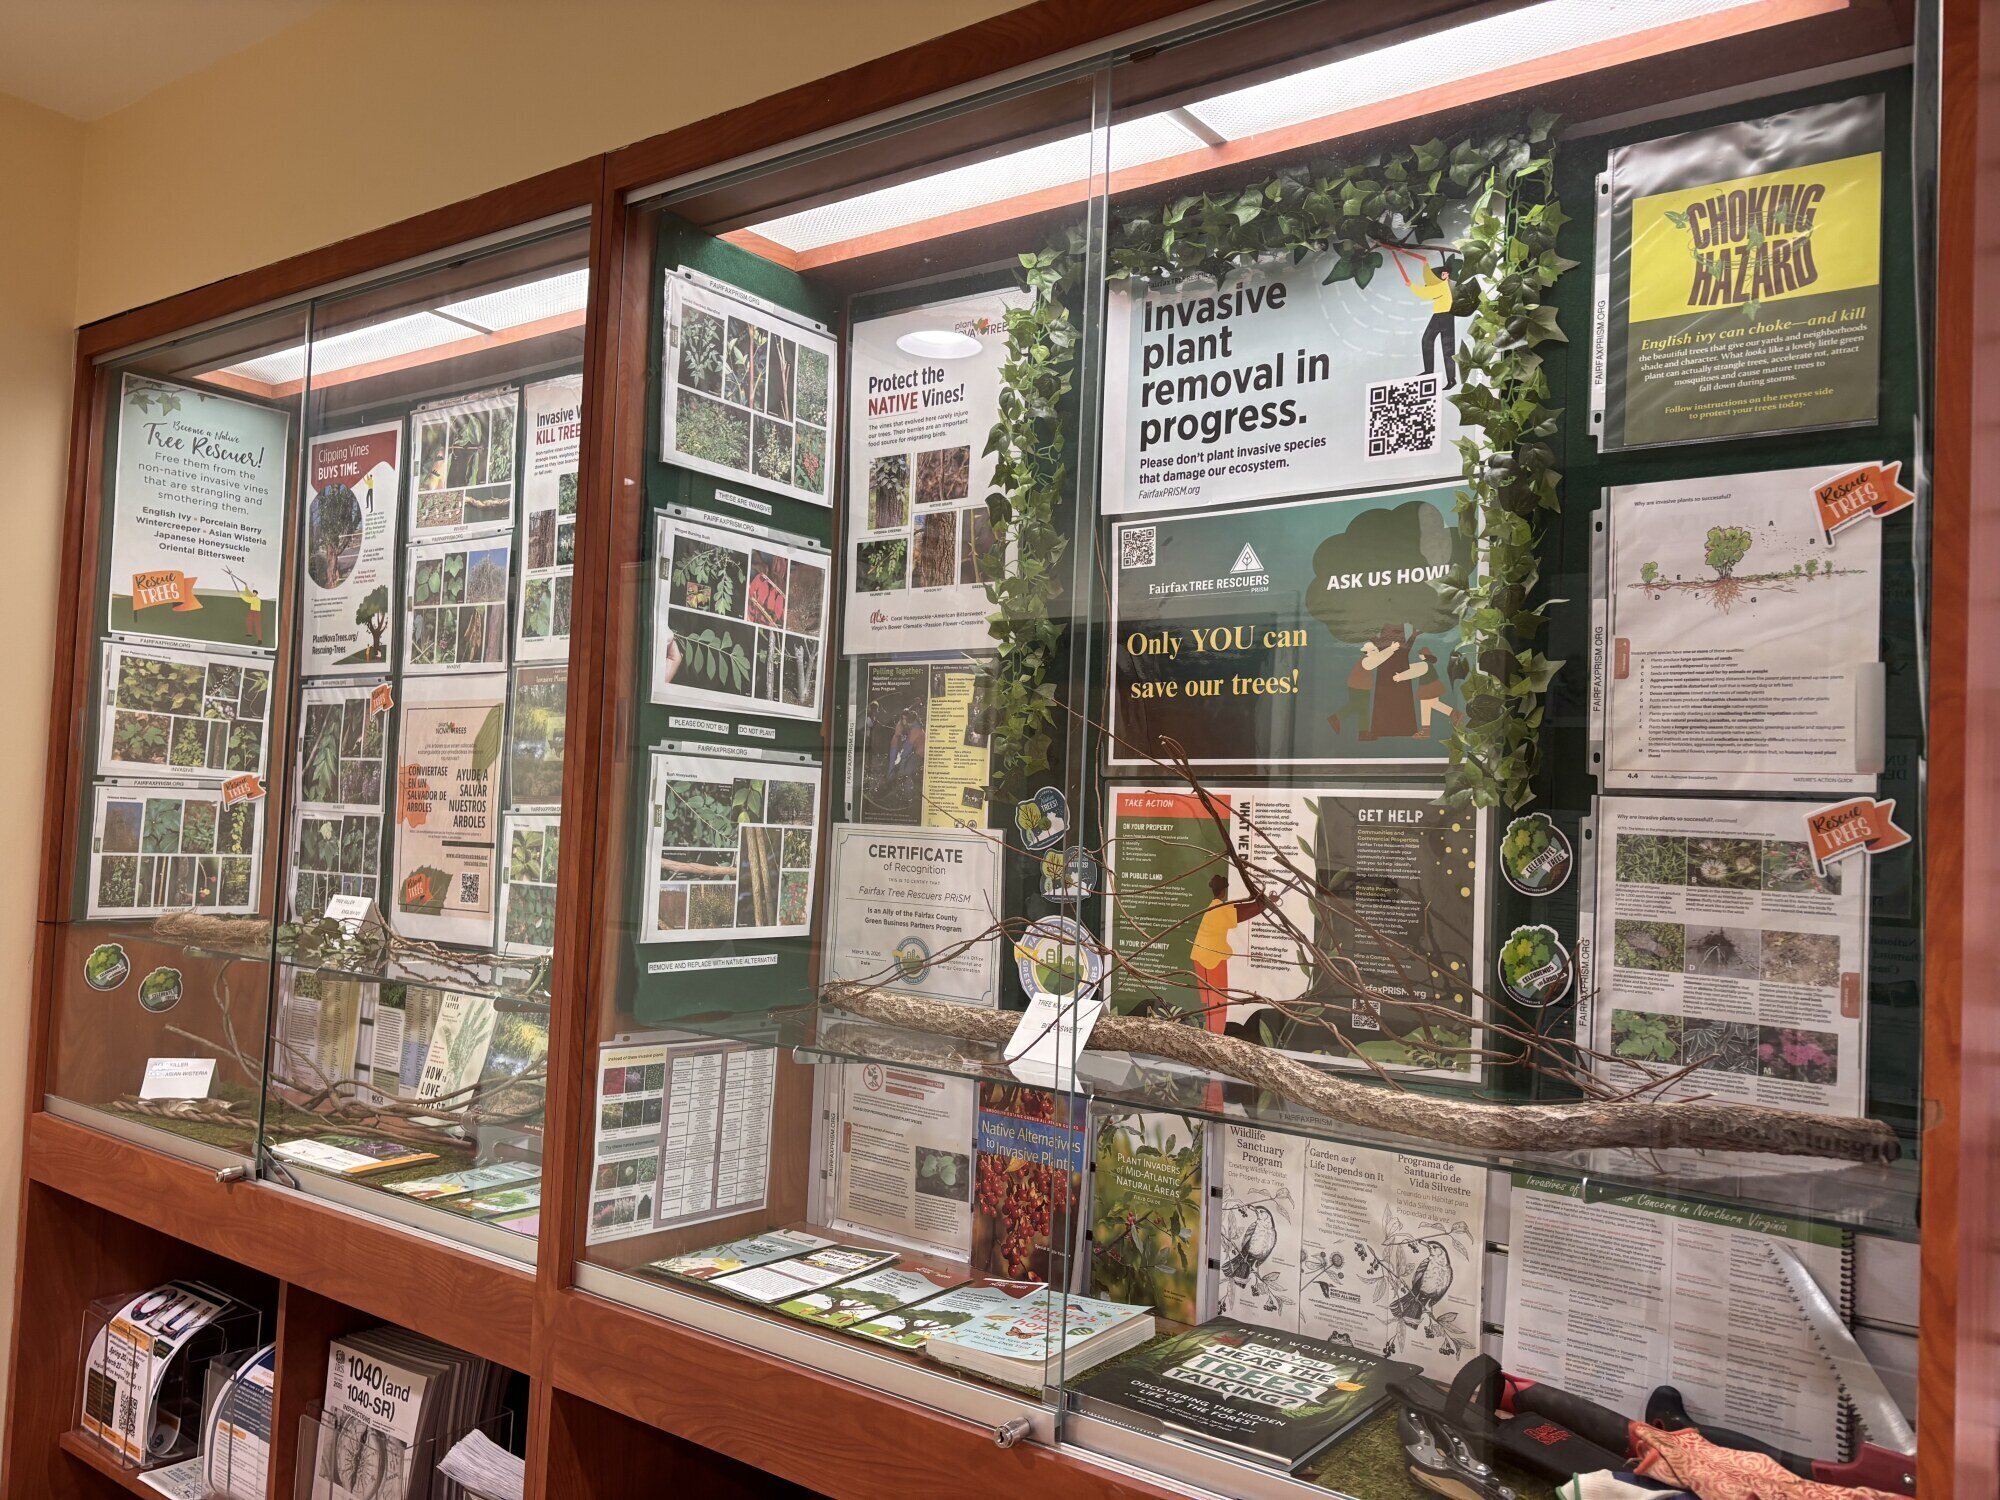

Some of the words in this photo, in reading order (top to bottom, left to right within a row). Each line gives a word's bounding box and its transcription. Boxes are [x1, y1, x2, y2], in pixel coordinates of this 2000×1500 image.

[1688, 184, 1825, 250] CHOKING
[1687, 236, 1818, 306] HAZARD
[1144, 280, 1286, 332] Invasive
[1641, 331, 1691, 351] English
[1696, 330, 1715, 344] ivy
[1719, 326, 1744, 338] can
[1840, 307, 1866, 321] kill
[1143, 326, 1232, 376] plant
[869, 374, 918, 394] Protect
[922, 366, 944, 384] the
[1142, 352, 1284, 407] removal
[1297, 349, 1330, 384] in
[868, 392, 918, 416] NATIVE
[922, 383, 964, 407] Vines!
[537, 412, 573, 427] Invasive
[1140, 398, 1308, 451] progress.
[143, 422, 184, 449] Tree
[173, 421, 204, 435] Become
[214, 431, 240, 443] Native
[536, 430, 554, 445] KILL
[319, 447, 347, 463] Clipping
[349, 443, 369, 458] Vines
[1140, 456, 1173, 469] Please
[1177, 452, 1204, 465] don't
[1207, 448, 1234, 463] plant
[1237, 442, 1281, 457] invasive
[1284, 436, 1326, 453] species
[155, 452, 177, 463] Free
[183, 457, 209, 469] them
[213, 463, 238, 474] from
[240, 470, 256, 480] the
[318, 466, 337, 480] BUYS
[339, 462, 360, 476] TIME.
[1139, 472, 1160, 484] that
[1164, 468, 1205, 484] damage
[1208, 465, 1225, 476] our
[1229, 458, 1289, 476] ecosystem.
[138, 463, 197, 479] non-native
[200, 474, 239, 489] invasive
[243, 483, 268, 494] vines
[144, 476, 166, 488] that
[170, 482, 187, 491] are
[190, 485, 241, 502] strangling
[244, 495, 263, 505] and
[1826, 484, 1878, 518] TREES
[158, 491, 218, 510] smothering
[222, 503, 249, 515] them.
[719, 492, 735, 502] THESE
[736, 496, 747, 506] ARE
[748, 498, 772, 513] INVASIVE
[1217, 575, 1269, 589] RESCUERS
[1327, 574, 1363, 590] ASK
[1368, 570, 1392, 587] US
[138, 583, 180, 604] TREES
[1127, 632, 1183, 660] Only
[1191, 625, 1255, 653] YOU
[1263, 630, 1307, 649] can
[1131, 676, 1177, 699] save
[1185, 679, 1224, 697] our
[1232, 669, 1299, 695] trees!
[674, 718, 696, 728] PLEASE
[696, 721, 705, 729] DO
[706, 722, 717, 731] NOT
[718, 723, 729, 732] BUY
[739, 726, 747, 734] DO
[748, 727, 758, 736] NOT
[456, 768, 480, 781] AYUDE
[482, 769, 488, 781] A
[460, 784, 487, 797] SALVAR
[449, 800, 486, 812] NUESTROS
[1124, 798, 1146, 807] TAKE
[1148, 799, 1173, 808] ACTION
[1358, 809, 1384, 822] GET
[1388, 810, 1423, 823] HELP
[1817, 818, 1872, 850] TREES
[869, 844, 963, 863] CERTIFICATE
[1526, 847, 1555, 877] CELEBRATE
[1546, 854, 1564, 869] TREES
[884, 862, 893, 871] of
[895, 862, 945, 875] Recognition
[888, 888, 904, 898] Tree
[907, 889, 942, 901] Rescuers
[865, 917, 882, 925] Green
[883, 918, 908, 927] Business
[910, 921, 934, 930] Partners
[935, 923, 962, 933] Program
[935, 913, 957, 922] County
[982, 1119, 1014, 1137] Native
[1230, 1126, 1266, 1140] Wildlife
[986, 1138, 995, 1148] to
[996, 1141, 1038, 1162] Invasive
[1237, 1140, 1284, 1158] Sanctuary
[1242, 1152, 1283, 1168] Program
[1116, 1166, 1123, 1176] of
[1398, 1154, 1441, 1170] Programa
[1443, 1163, 1454, 1171] de
[1404, 1166, 1445, 1182] Santuario
[1450, 1174, 1461, 1183] de
[1409, 1177, 1429, 1189] Vida
[1431, 1182, 1471, 1197] Silvestre
[1569, 1184, 1580, 1197] of
[1638, 1194, 1677, 1212] Concern
[1681, 1205, 1690, 1215] in
[1693, 1203, 1743, 1224] Northern
[1749, 1216, 1788, 1233] Virginia
[131, 1289, 212, 1340] OLLI
[1214, 1346, 1287, 1368] HEAR
[1290, 1366, 1337, 1383] THE
[1248, 1344, 1287, 1356] CAN
[1291, 1353, 1330, 1370] YOU
[348, 1356, 383, 1389] 1040
[383, 1375, 410, 1402] (and
[1198, 1355, 1323, 1396] TREES
[1170, 1369, 1300, 1408] TALKING?
[347, 1384, 395, 1421] 1040-SR)
